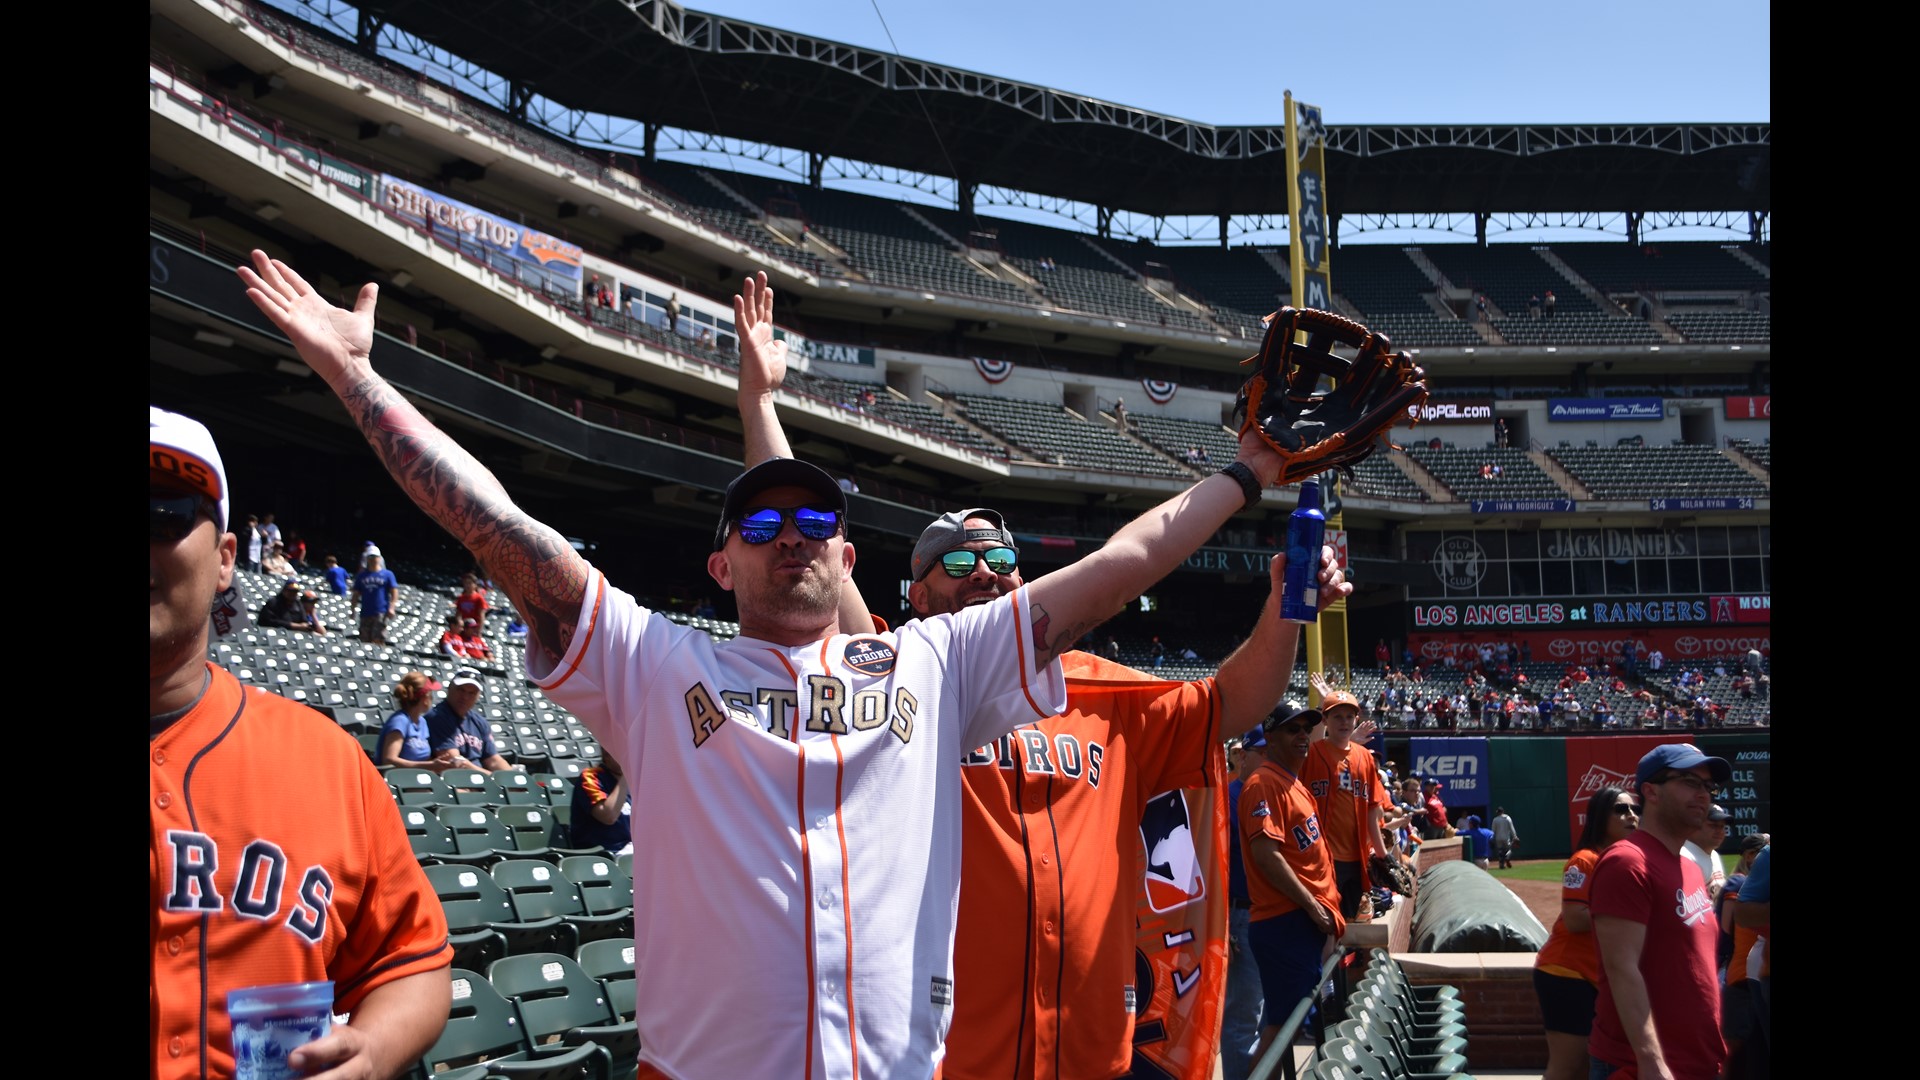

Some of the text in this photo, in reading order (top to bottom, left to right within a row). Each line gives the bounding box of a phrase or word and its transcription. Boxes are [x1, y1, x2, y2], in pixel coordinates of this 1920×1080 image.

[386, 182, 518, 249] SHOCK TOP
[1302, 176, 1320, 263] EAT
[823, 344, 860, 364] FAN
[1566, 406, 1606, 415] Albertsons
[1609, 405, 1629, 415] Tom
[1630, 403, 1660, 415] Thumb
[1477, 501, 1484, 512] 7
[1564, 500, 1571, 511] 7
[1652, 498, 1752, 510] 34 NOLAN RYAN 34
[1448, 540, 1470, 549] OLD
[1547, 529, 1688, 558] JACK DANIEL'S
[1449, 577, 1473, 586] CLUB
[1739, 597, 1770, 609] MON
[1414, 600, 1707, 625] LOS ANGELES at RANGERS
[849, 648, 893, 665] STRONG
[684, 674, 919, 749] ASTROS
[961, 729, 1105, 790] STROS
[1732, 770, 1755, 783] CLE
[1450, 778, 1477, 790] TIRES
[1733, 786, 1757, 800] SEA
[1735, 806, 1758, 819] NYY
[166, 829, 335, 945] ROS
